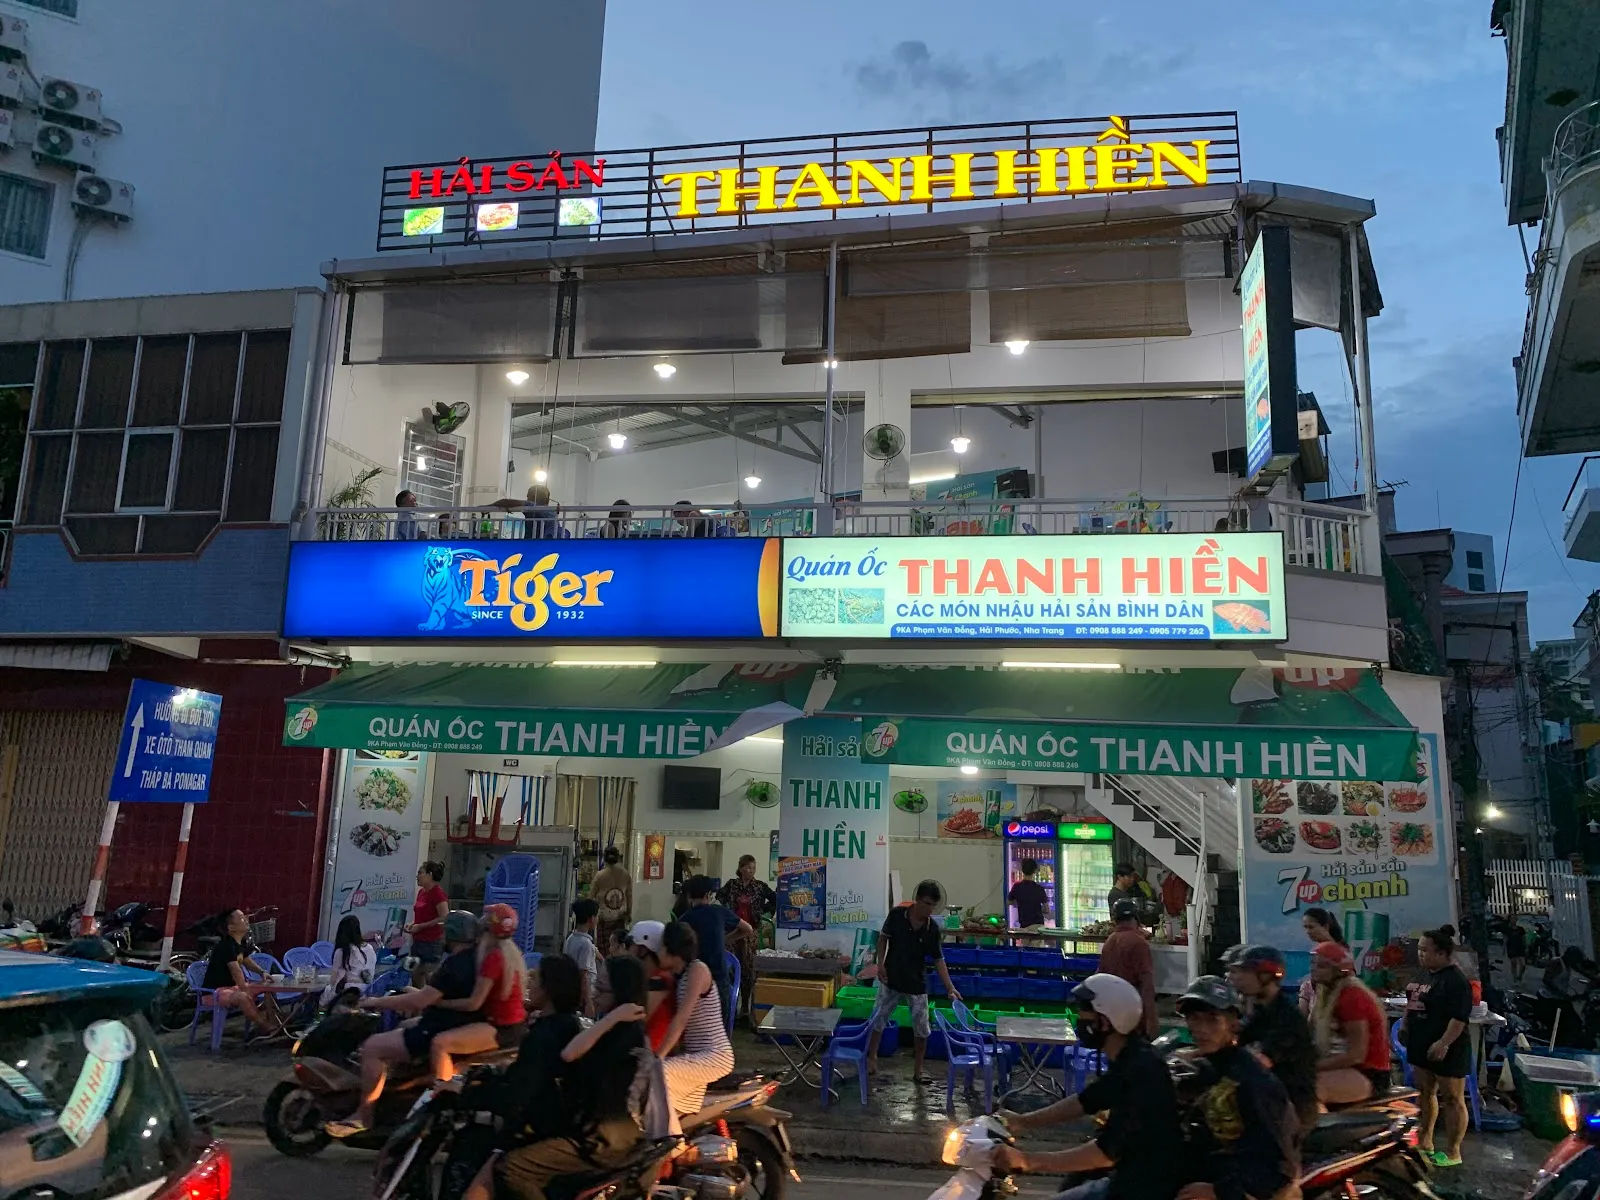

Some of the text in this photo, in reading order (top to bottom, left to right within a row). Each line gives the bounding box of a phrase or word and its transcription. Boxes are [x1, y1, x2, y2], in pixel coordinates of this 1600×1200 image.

[409, 149, 607, 199] HẢI SẢN
[663, 115, 1210, 217] THANH HIỀN
[786, 547, 888, 582] Quán Ốc
[898, 538, 1271, 596] THANH HIỀN
[459, 553, 614, 631] Tiger
[471, 610, 584, 619] SINCE 1932
[896, 598, 1204, 621] CÁC MÓN NHẬU HẢI SẢN BÌNH DÂN
[896, 626, 911, 634] 9KA
[1042, 627, 1064, 636] Trang
[145, 732, 213, 760] XE ÔTÔ THAM QUAN
[369, 714, 440, 738] QUÁN
[495, 721, 625, 754] THANH
[801, 734, 834, 757] Hải
[947, 728, 1027, 755] QUÁN
[1090, 737, 1243, 774] THANH
[1260, 735, 1367, 777] HIỀN
[140, 766, 207, 791] THÁP BÀ PONAGAR
[789, 779, 881, 809] THANH
[802, 821, 866, 859] HIỀN
[1021, 825, 1049, 835] pepsi
[1321, 855, 1407, 877] Hải sản cần
[1323, 873, 1408, 901] chanh
